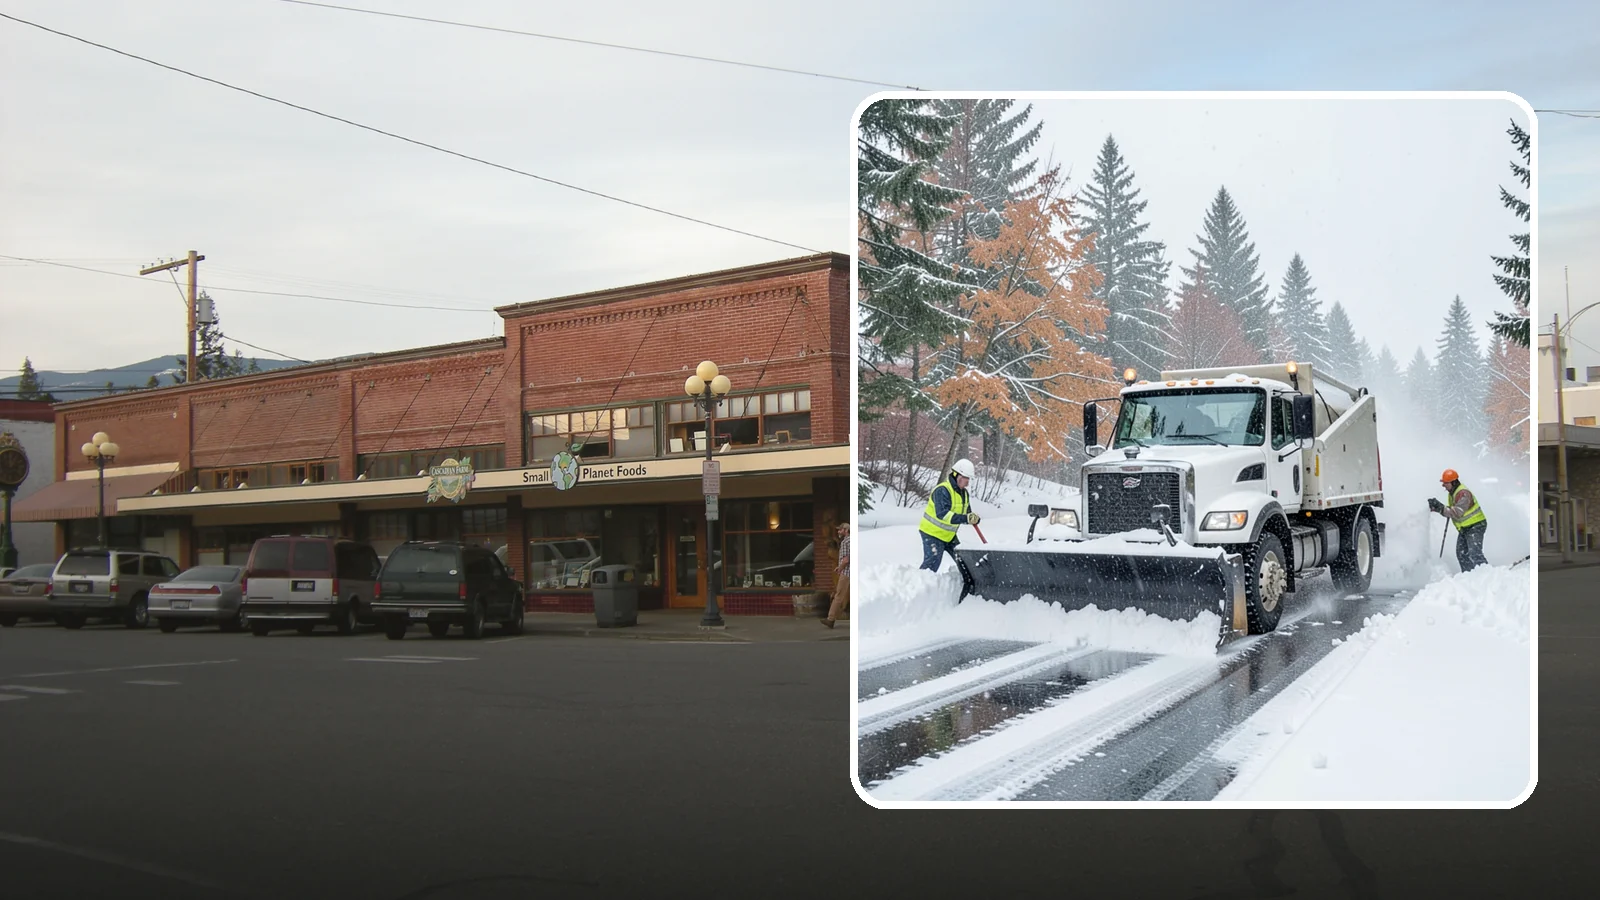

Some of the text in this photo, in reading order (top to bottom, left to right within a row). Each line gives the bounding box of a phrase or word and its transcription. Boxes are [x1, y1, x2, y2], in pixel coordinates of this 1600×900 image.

[431, 466, 456, 476] CASCADIAN
[523, 464, 647, 483] Small Planet Foods
